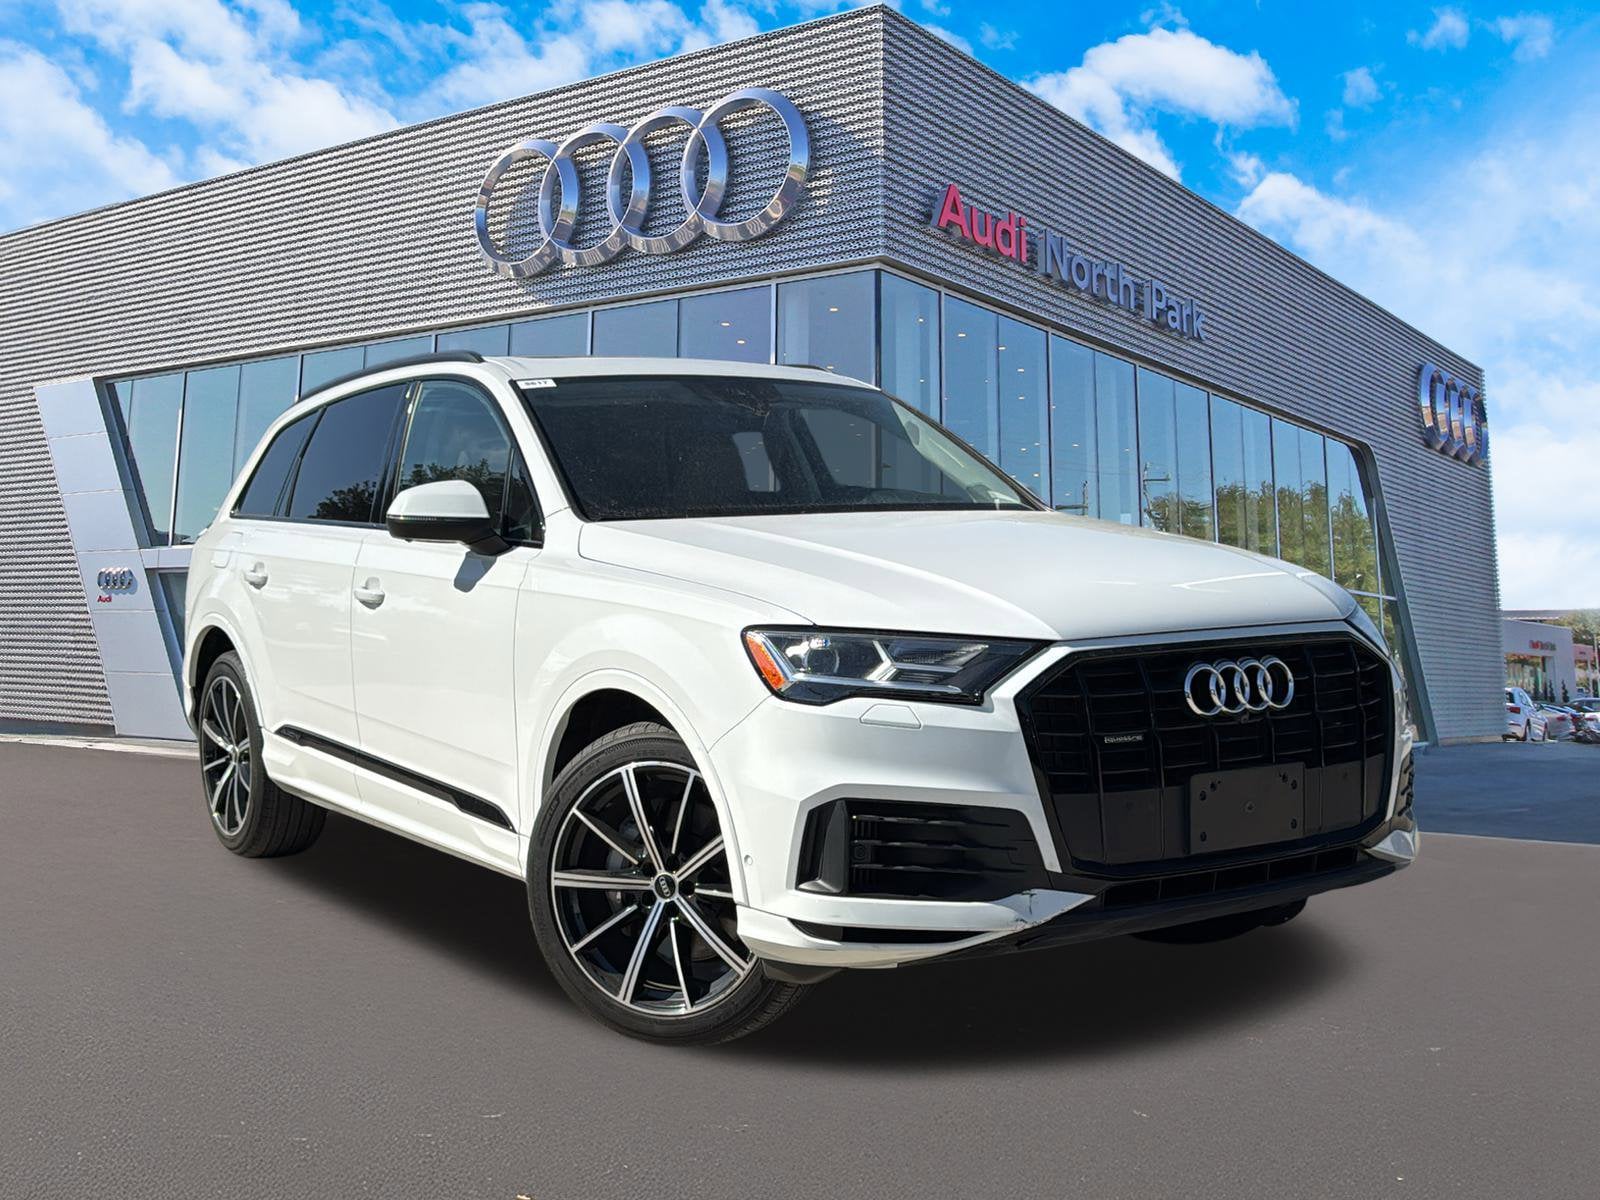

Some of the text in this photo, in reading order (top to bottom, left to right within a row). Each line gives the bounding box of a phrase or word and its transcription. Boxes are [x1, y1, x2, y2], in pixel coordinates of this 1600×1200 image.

[935, 183, 1207, 340] Audi North Park
